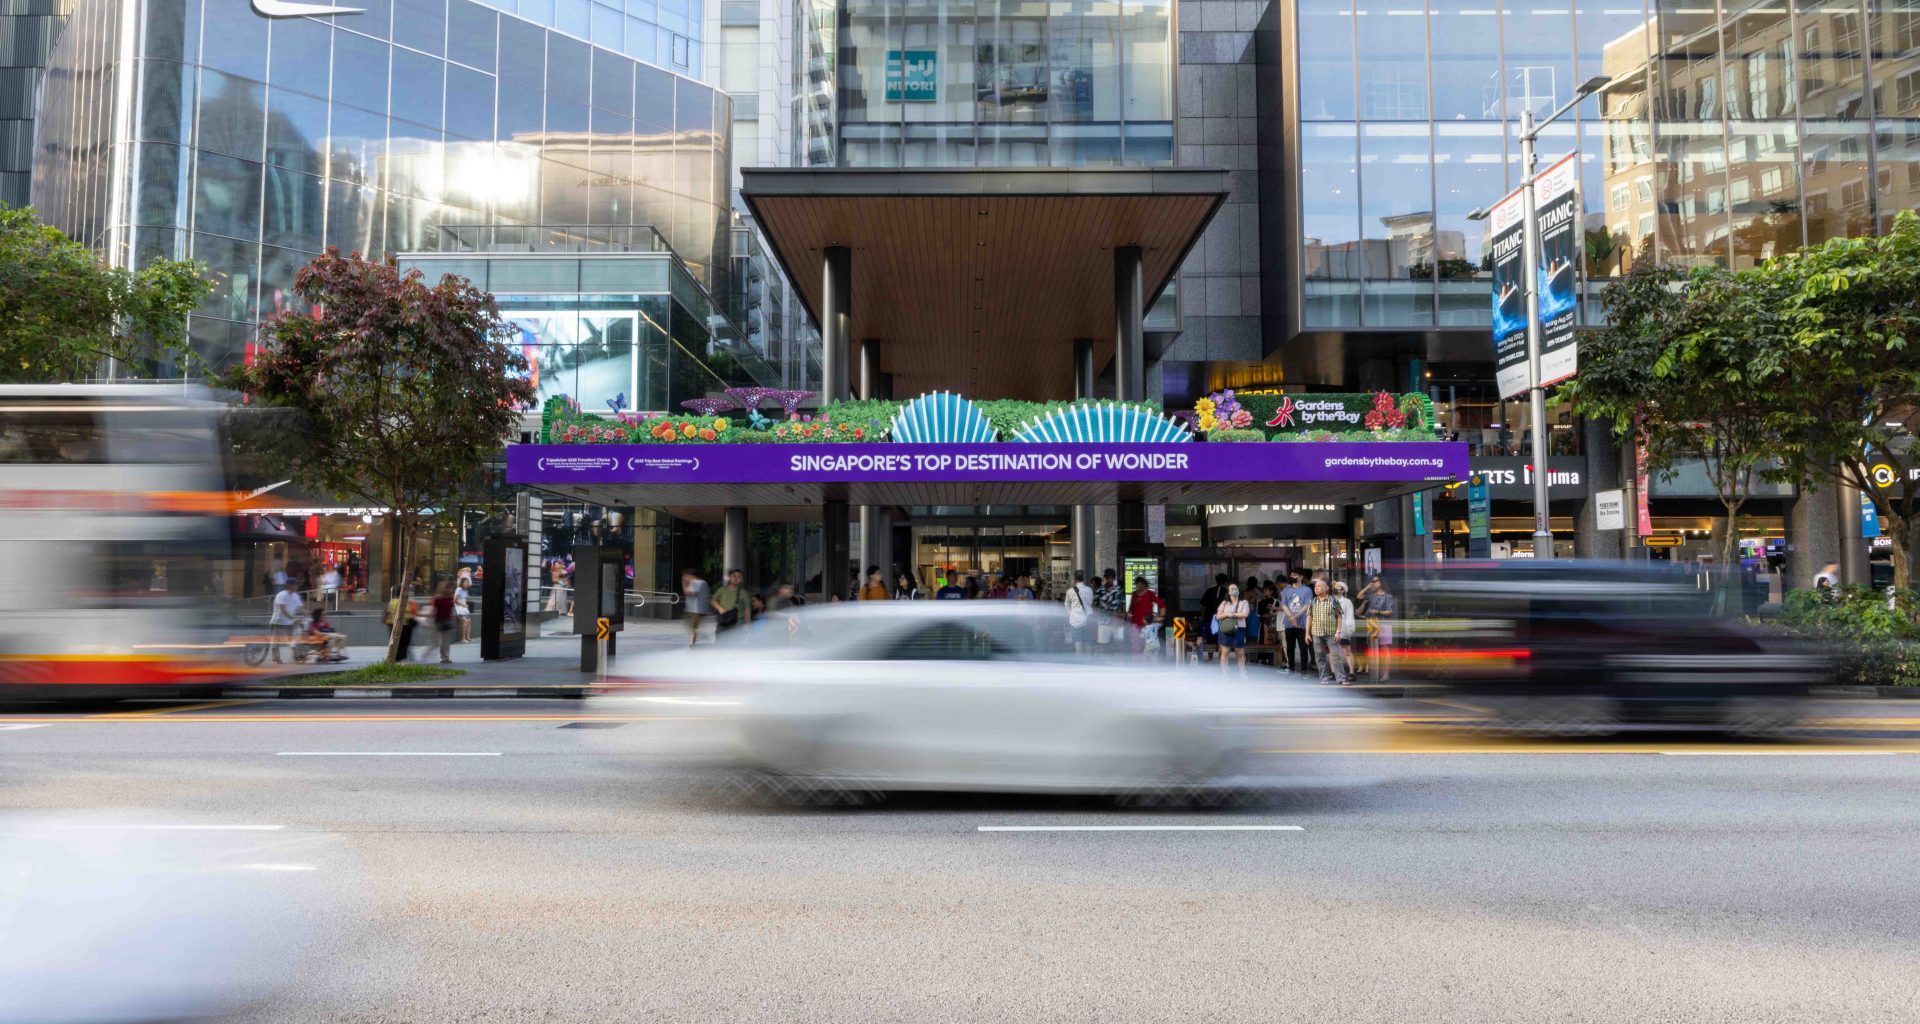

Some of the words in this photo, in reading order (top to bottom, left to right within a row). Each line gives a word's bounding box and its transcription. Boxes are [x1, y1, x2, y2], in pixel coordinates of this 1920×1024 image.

[887, 60, 934, 78] ニトリ
[887, 81, 934, 91] NITORI
[1538, 200, 1573, 232] TITANIC
[1492, 229, 1523, 259] TITANIC
[1294, 400, 1344, 411] Gardens
[790, 454, 912, 471] SINGAPORE’S
[914, 454, 951, 471] TOP
[955, 453, 1072, 470] DESTINATION
[1076, 453, 1102, 470] OF
[1104, 453, 1188, 470] WONDER
[1324, 456, 1444, 468] gardensbythebay.com.sg
